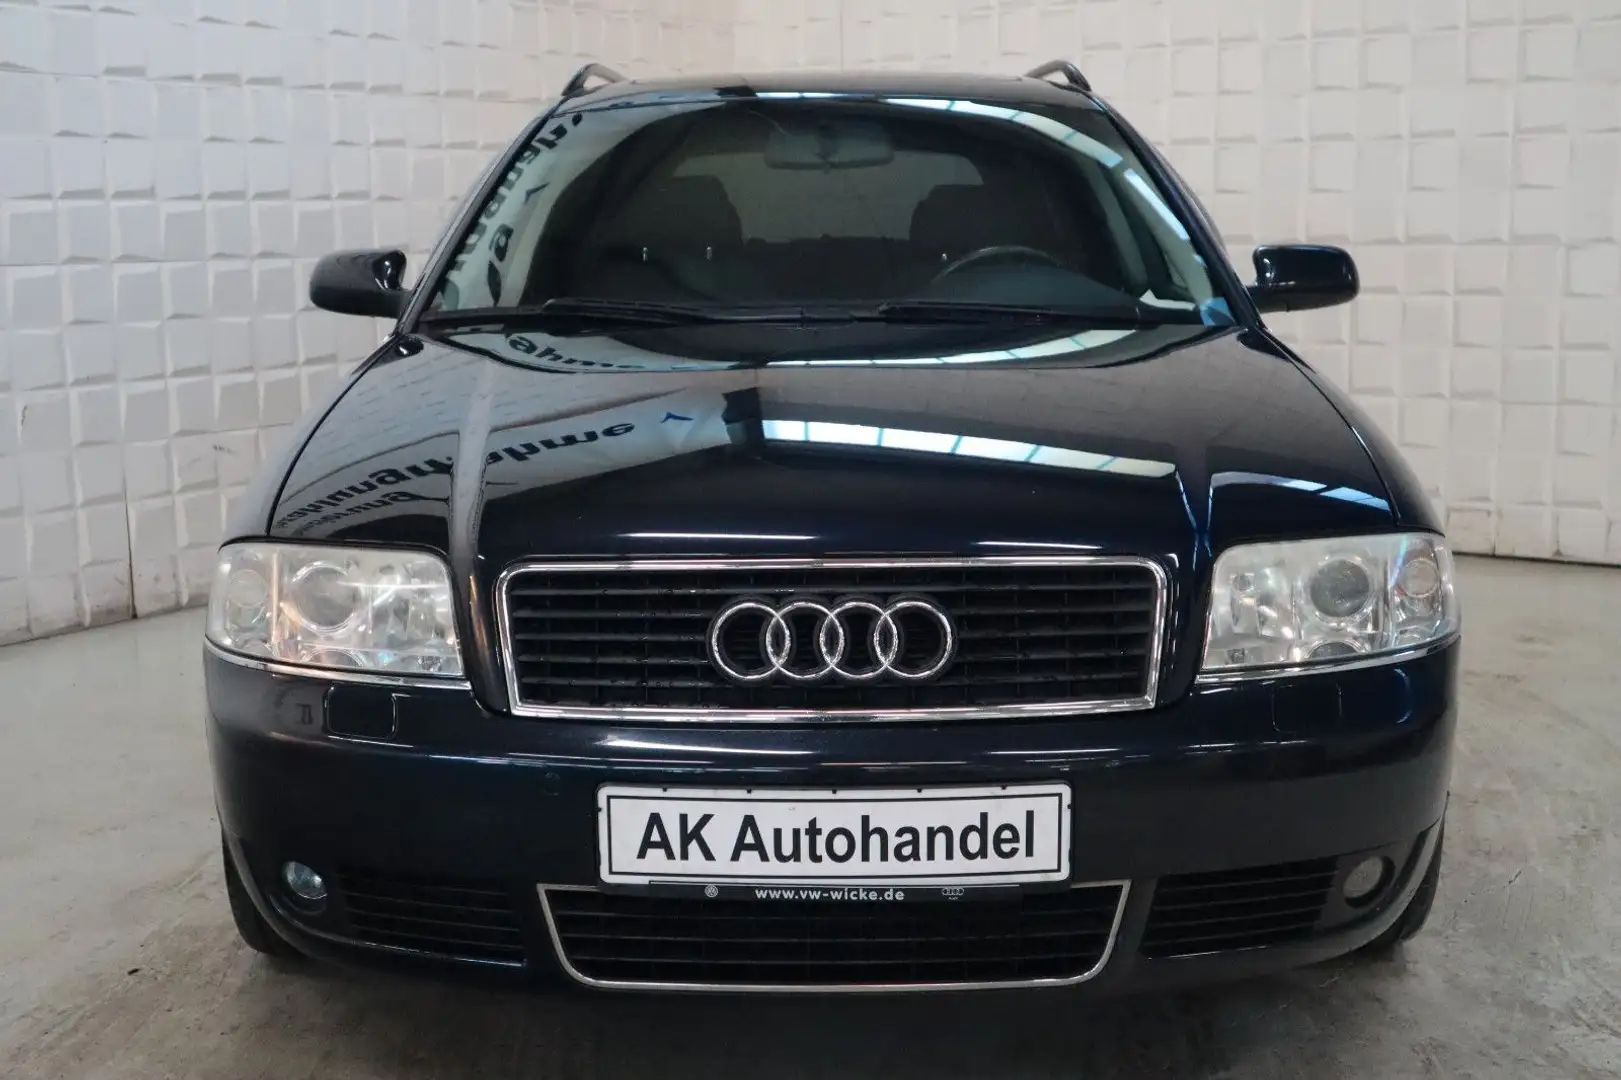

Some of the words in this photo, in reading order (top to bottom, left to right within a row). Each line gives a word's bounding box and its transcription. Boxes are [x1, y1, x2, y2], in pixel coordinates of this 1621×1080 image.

[637, 813, 717, 861] AK
[730, 810, 1035, 864] Autohandel
[755, 889, 905, 901] www.vw-wicke.de
